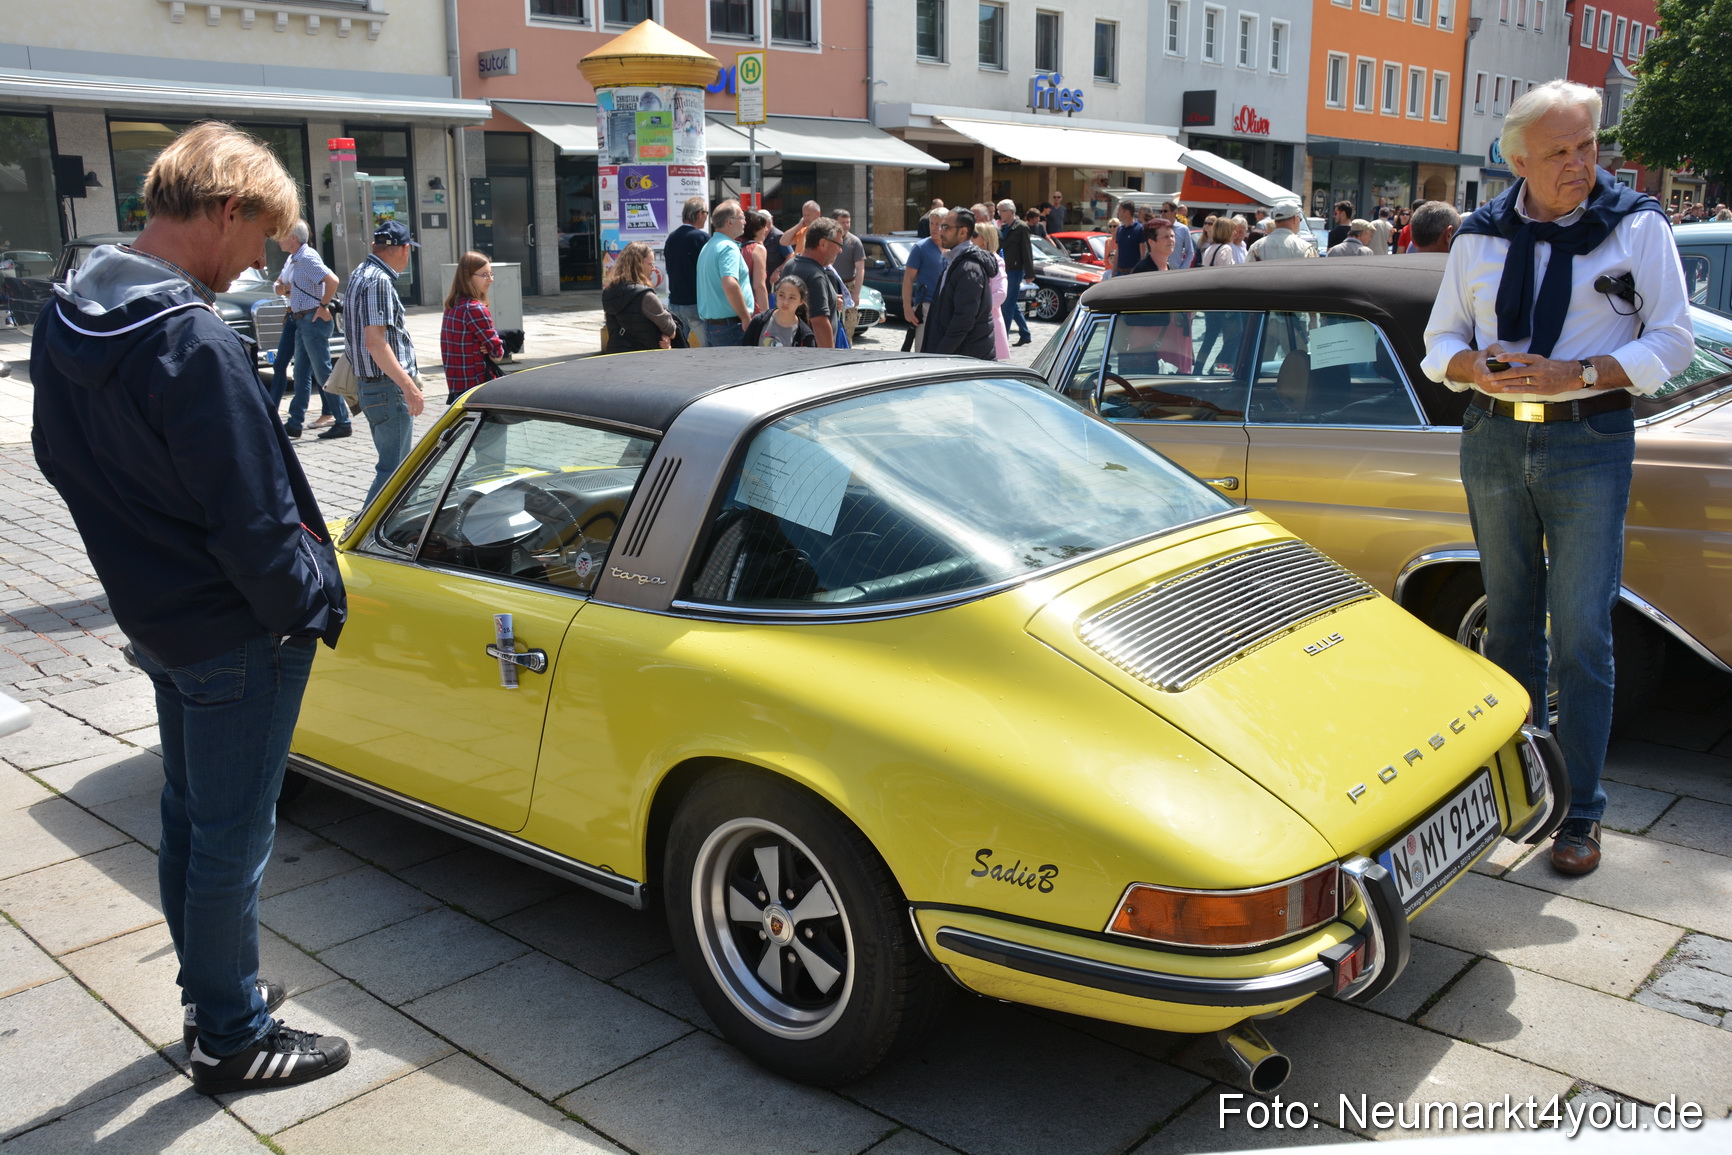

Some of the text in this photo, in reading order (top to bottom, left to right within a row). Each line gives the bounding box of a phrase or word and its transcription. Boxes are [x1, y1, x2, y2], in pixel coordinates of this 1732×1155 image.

[745, 62, 756, 79] H
[616, 95, 639, 103] CHRISTIAN
[616, 102, 638, 111] SPRINGER
[1234, 104, 1270, 135] s.Oliver
[611, 566, 667, 585] targa
[1347, 693, 1499, 805] PORSCHE
[1393, 778, 1495, 897] N MY 911H
[971, 848, 1059, 894] SadieB
